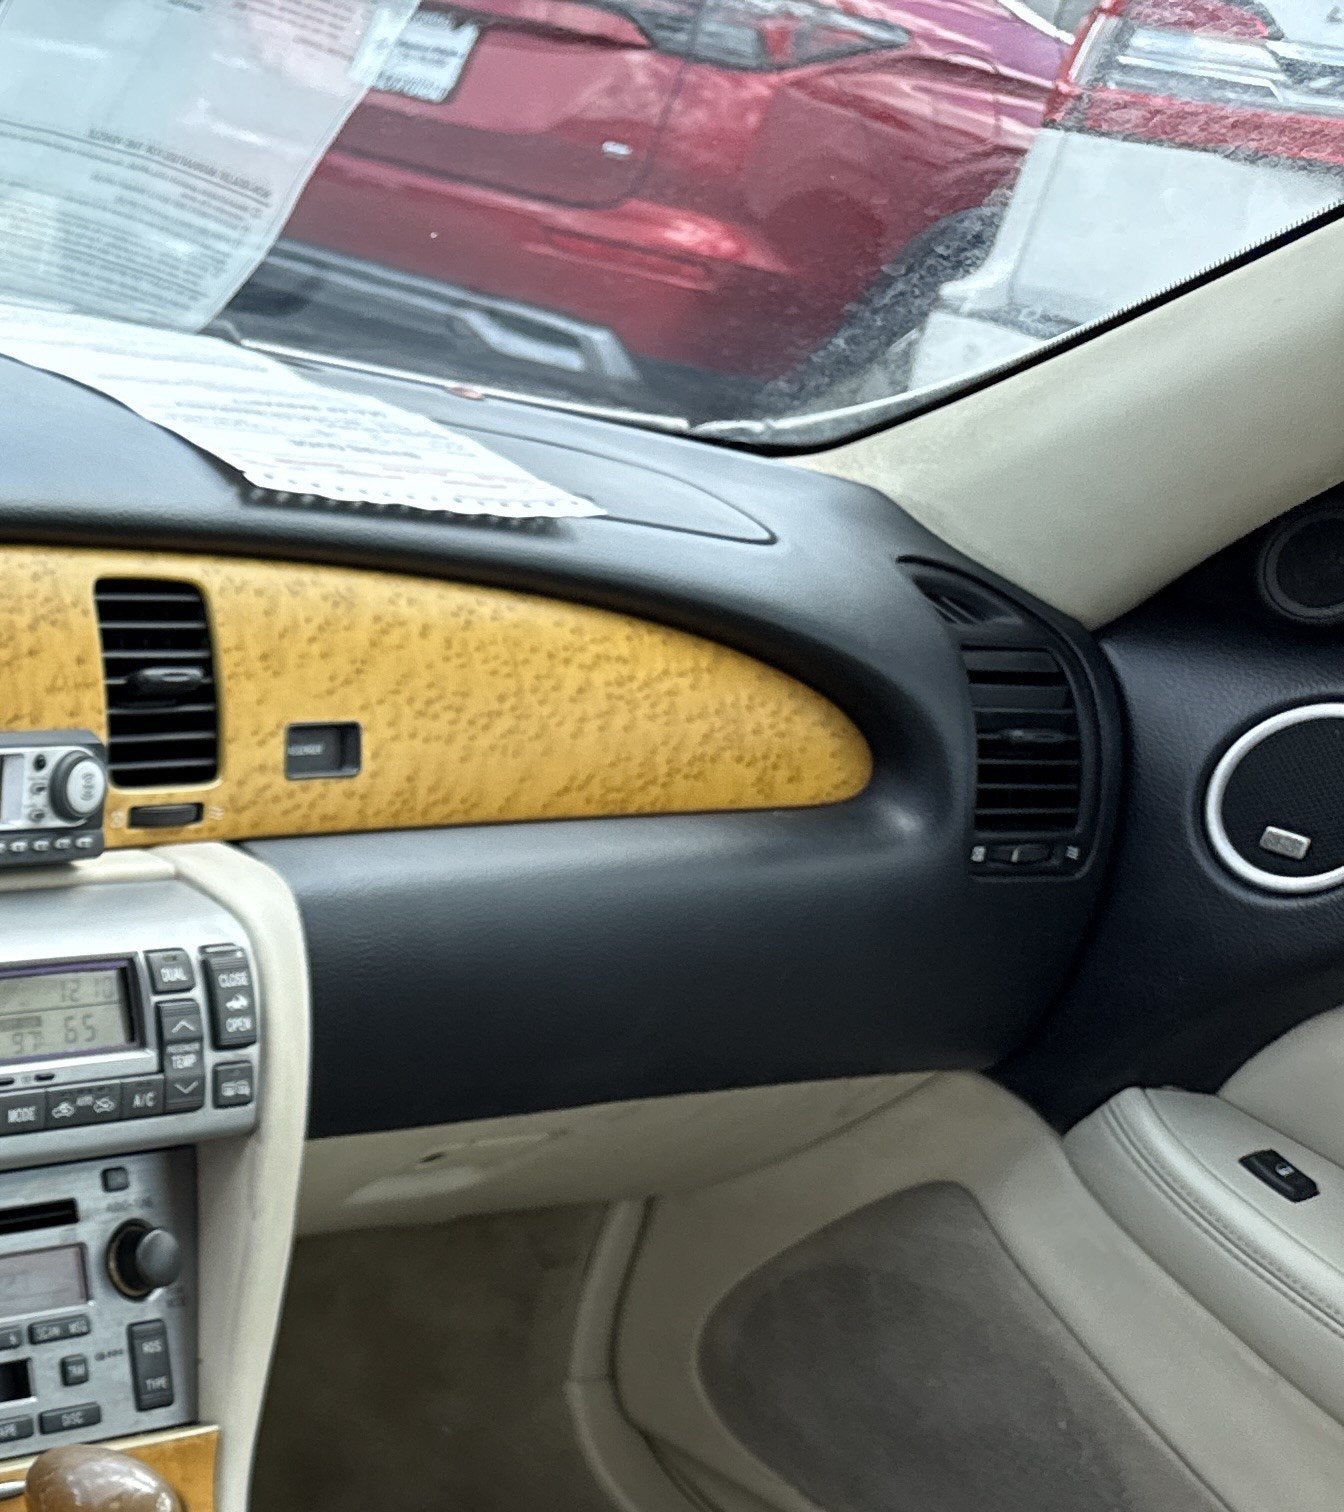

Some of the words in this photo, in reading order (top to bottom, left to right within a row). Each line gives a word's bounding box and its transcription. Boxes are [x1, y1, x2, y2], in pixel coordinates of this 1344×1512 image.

[217, 971, 249, 988] CLOSE
[63, 1013, 97, 1044] 65
[225, 1017, 251, 1033] OPEN
[132, 1091, 155, 1109] A/C
[7, 1106, 36, 1124] MODE
[145, 1375, 168, 1391] TYPE
